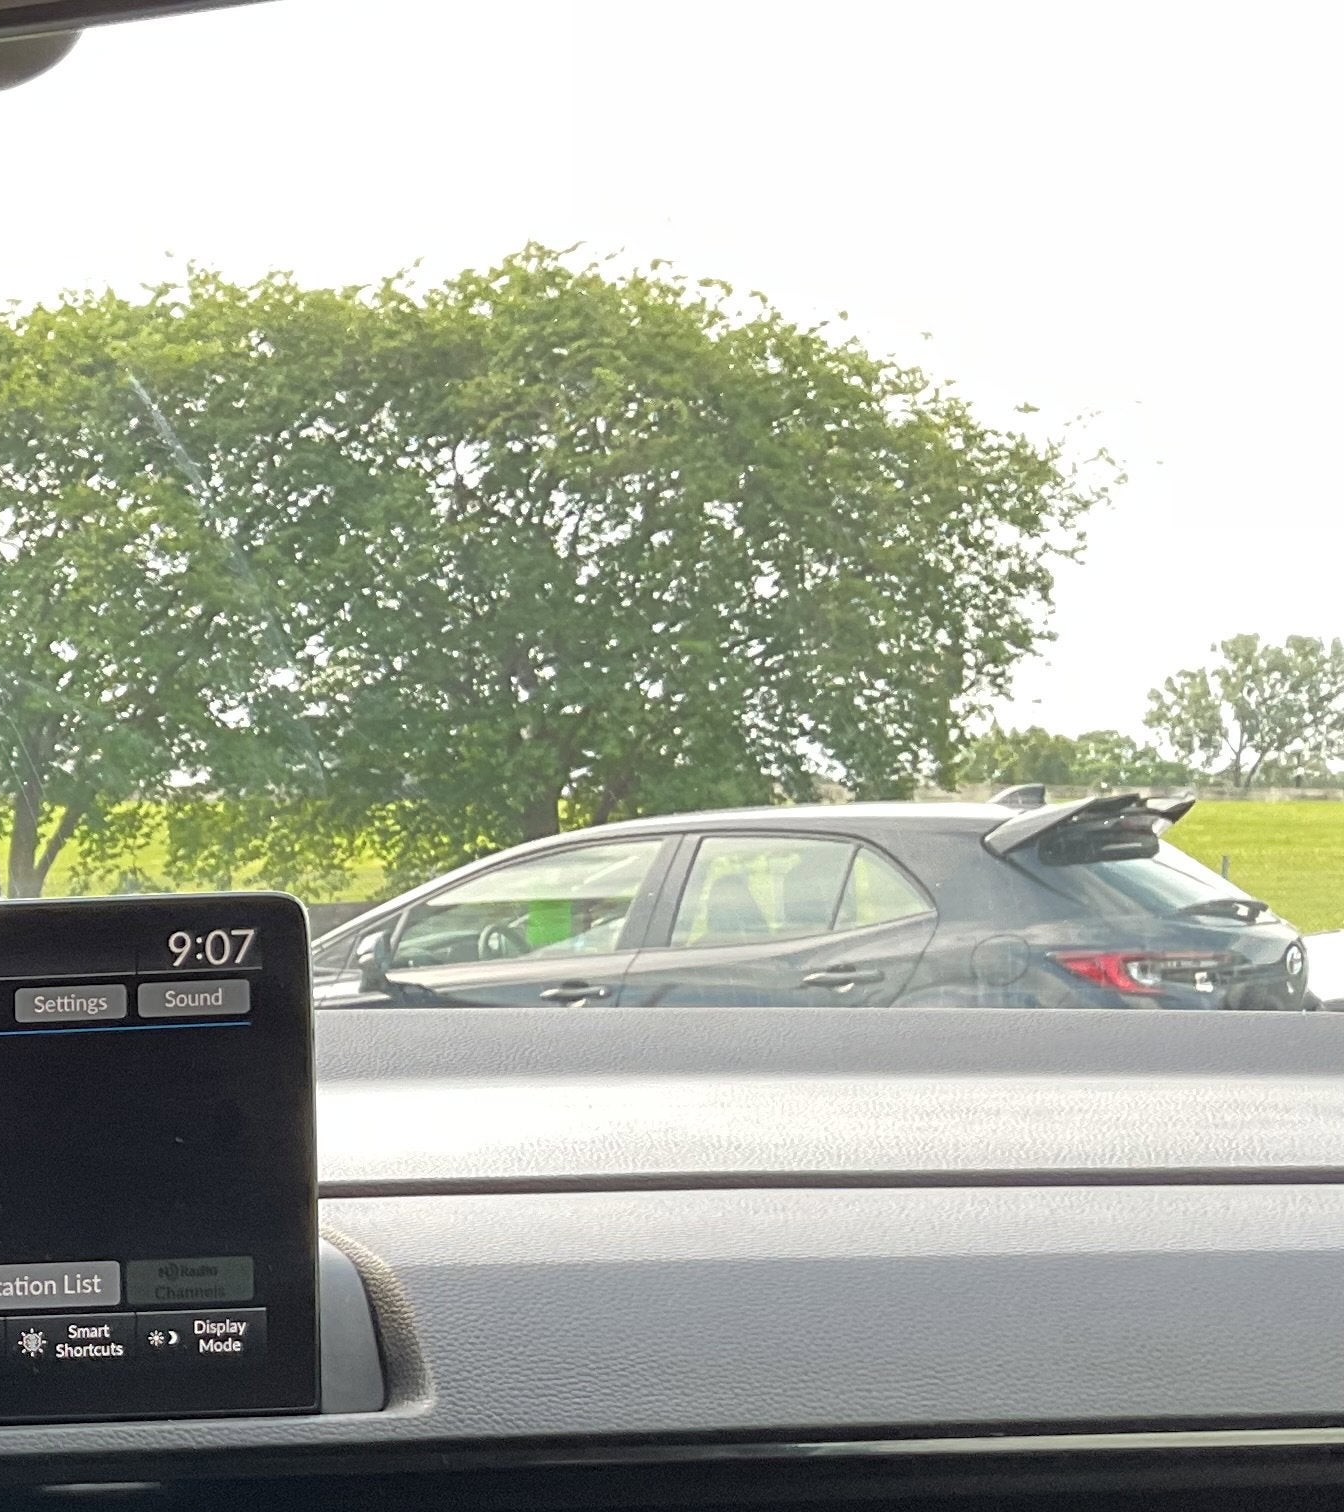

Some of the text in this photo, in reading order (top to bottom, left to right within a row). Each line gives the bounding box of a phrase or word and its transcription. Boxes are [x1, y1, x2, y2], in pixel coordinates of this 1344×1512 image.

[167, 928, 256, 967] 9:07
[34, 994, 108, 1016] Settings
[164, 988, 223, 1008] Sound
[63, 1273, 102, 1295] List
[68, 1322, 110, 1339] Smart
[193, 1319, 247, 1338] Display
[56, 1341, 124, 1358] Shortcuts
[199, 1337, 241, 1353] Mode
